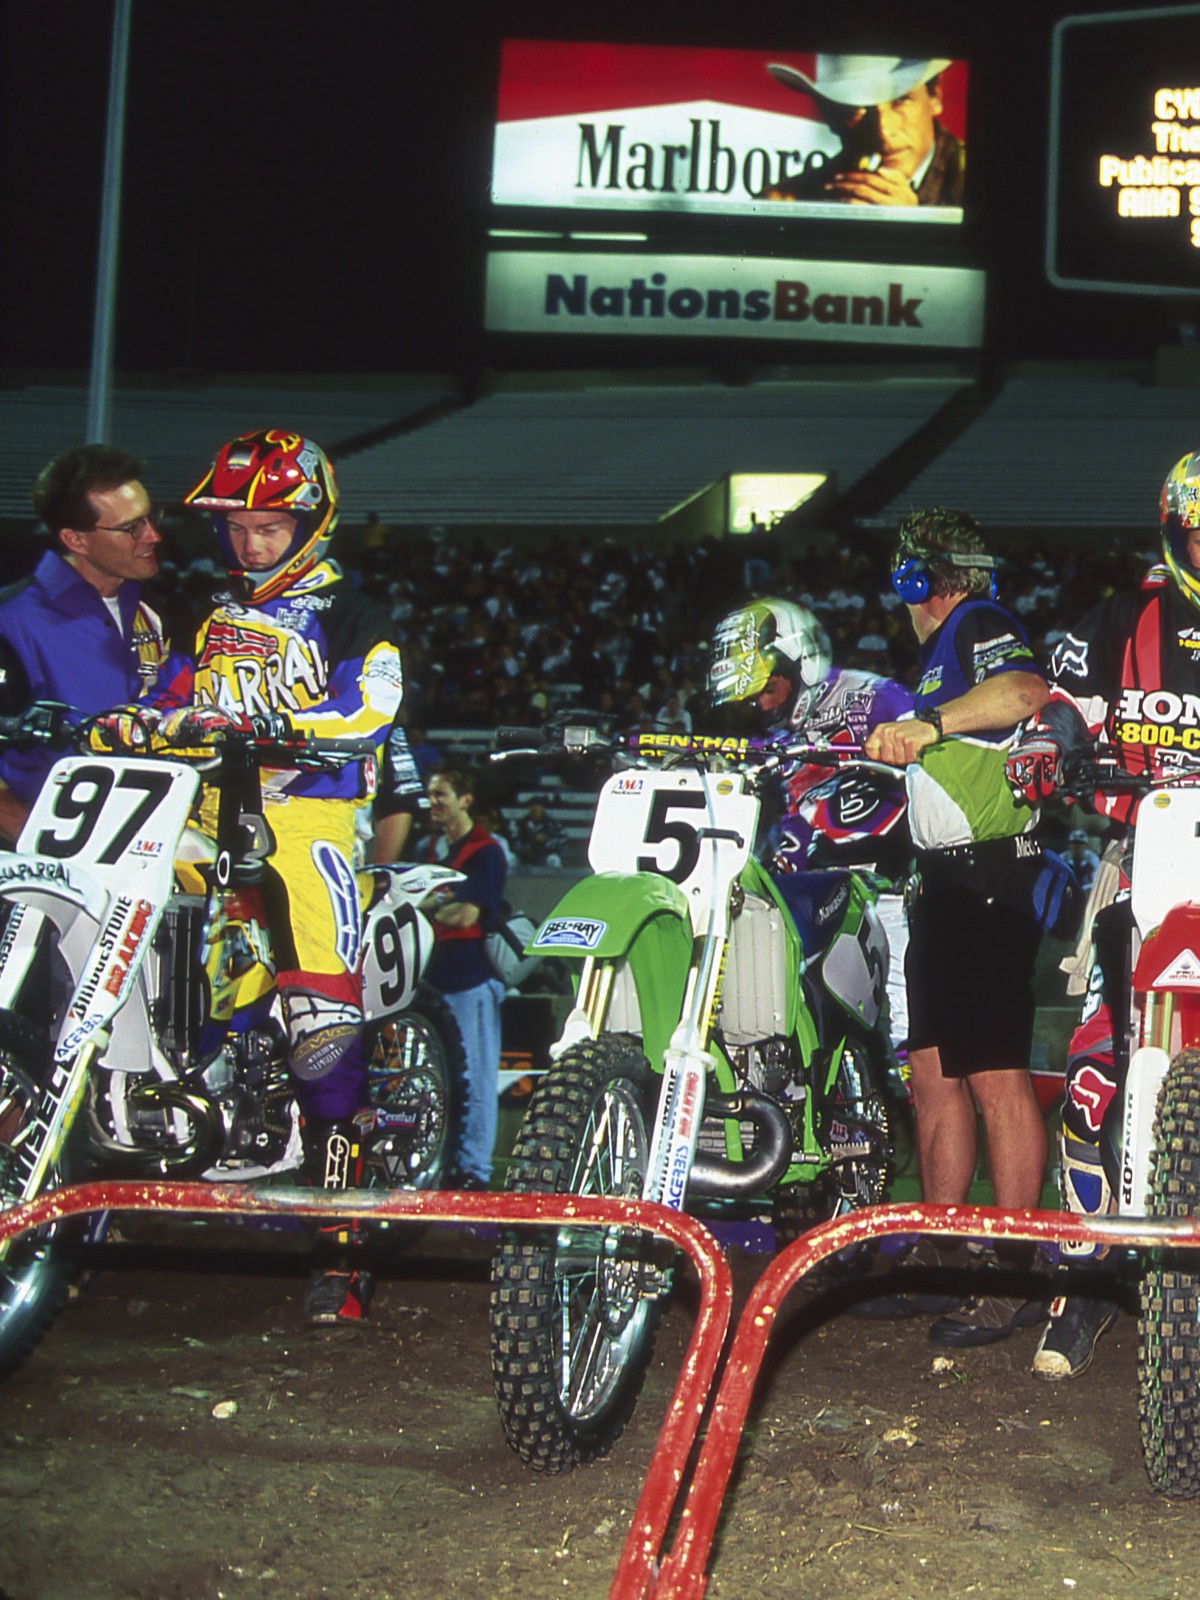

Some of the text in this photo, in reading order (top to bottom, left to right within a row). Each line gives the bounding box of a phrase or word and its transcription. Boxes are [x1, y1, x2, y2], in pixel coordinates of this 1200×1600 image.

[544, 273, 923, 328] NationsBank
[36, 764, 175, 865] 97
[616, 780, 644, 789] AMA
[637, 789, 707, 886] 5
[0, 861, 84, 896] HAPARRAL
[816, 883, 848, 924] Kawasaki
[103, 897, 153, 999] BRAKING
[373, 901, 422, 1008] 97
[678, 1071, 700, 1138] BRAKING
